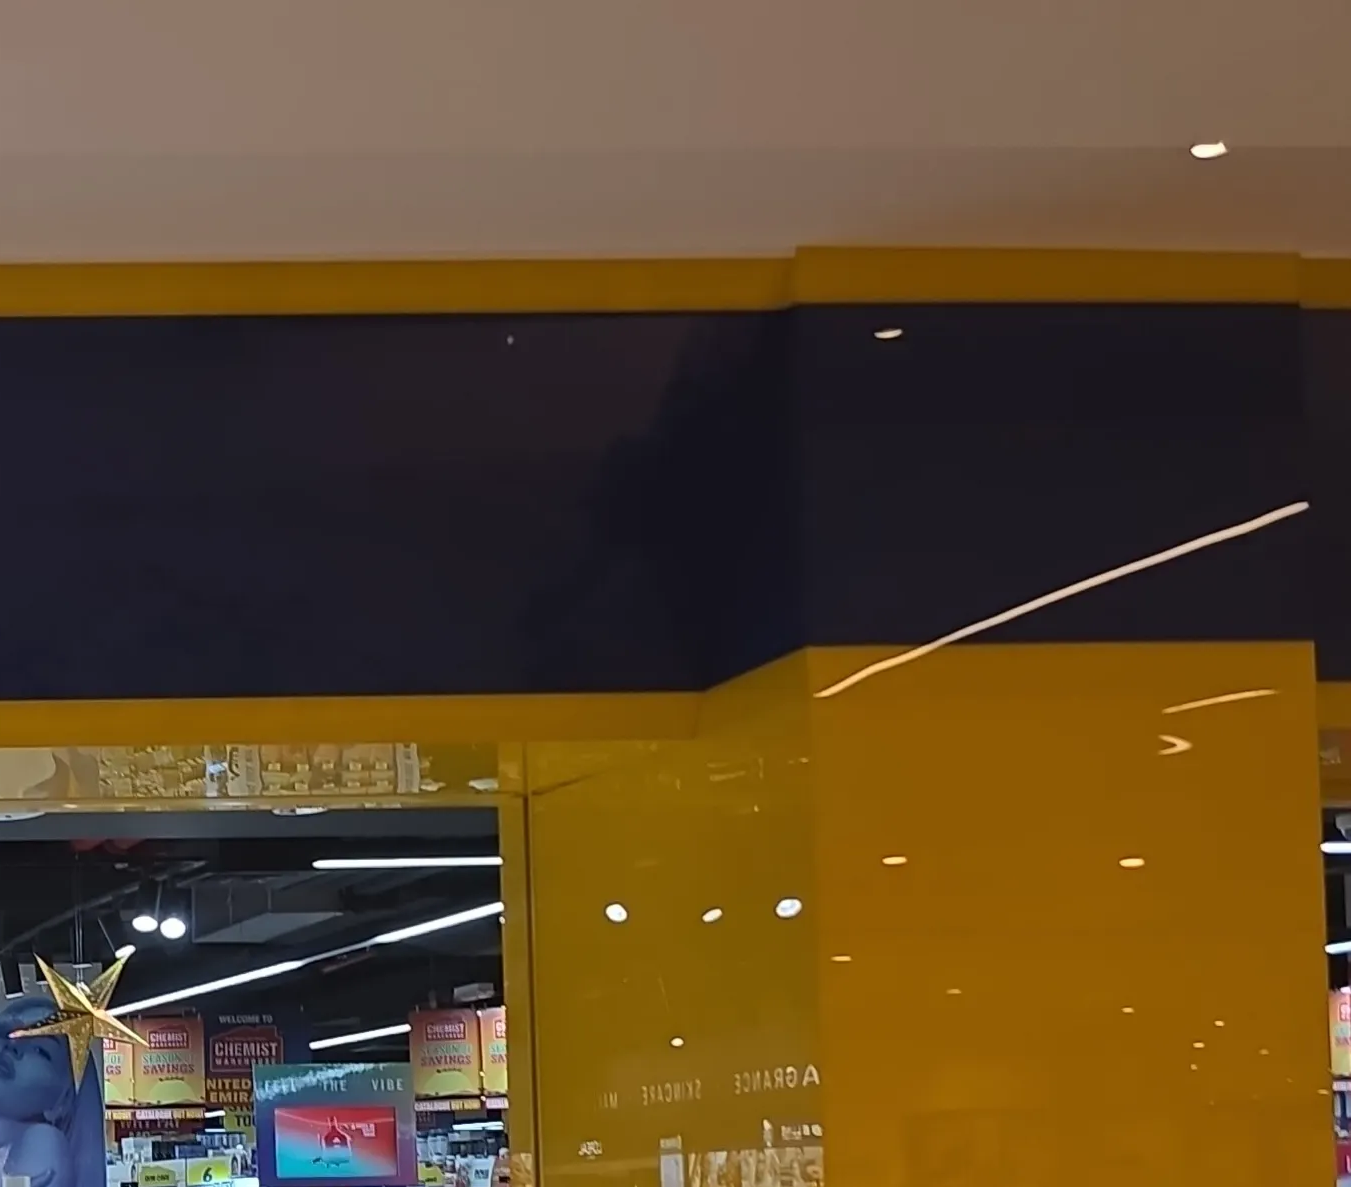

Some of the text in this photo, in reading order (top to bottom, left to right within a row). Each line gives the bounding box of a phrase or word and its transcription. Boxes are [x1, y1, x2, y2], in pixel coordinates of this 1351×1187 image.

[150, 1032, 187, 1042] CHEMIST
[214, 1041, 278, 1057] CHEMIST
[420, 1055, 472, 1066] SAVINGS
[143, 1063, 195, 1075] SAVINGS
[206, 1078, 252, 1090] NITED
[209, 1091, 253, 1103] EMIR
